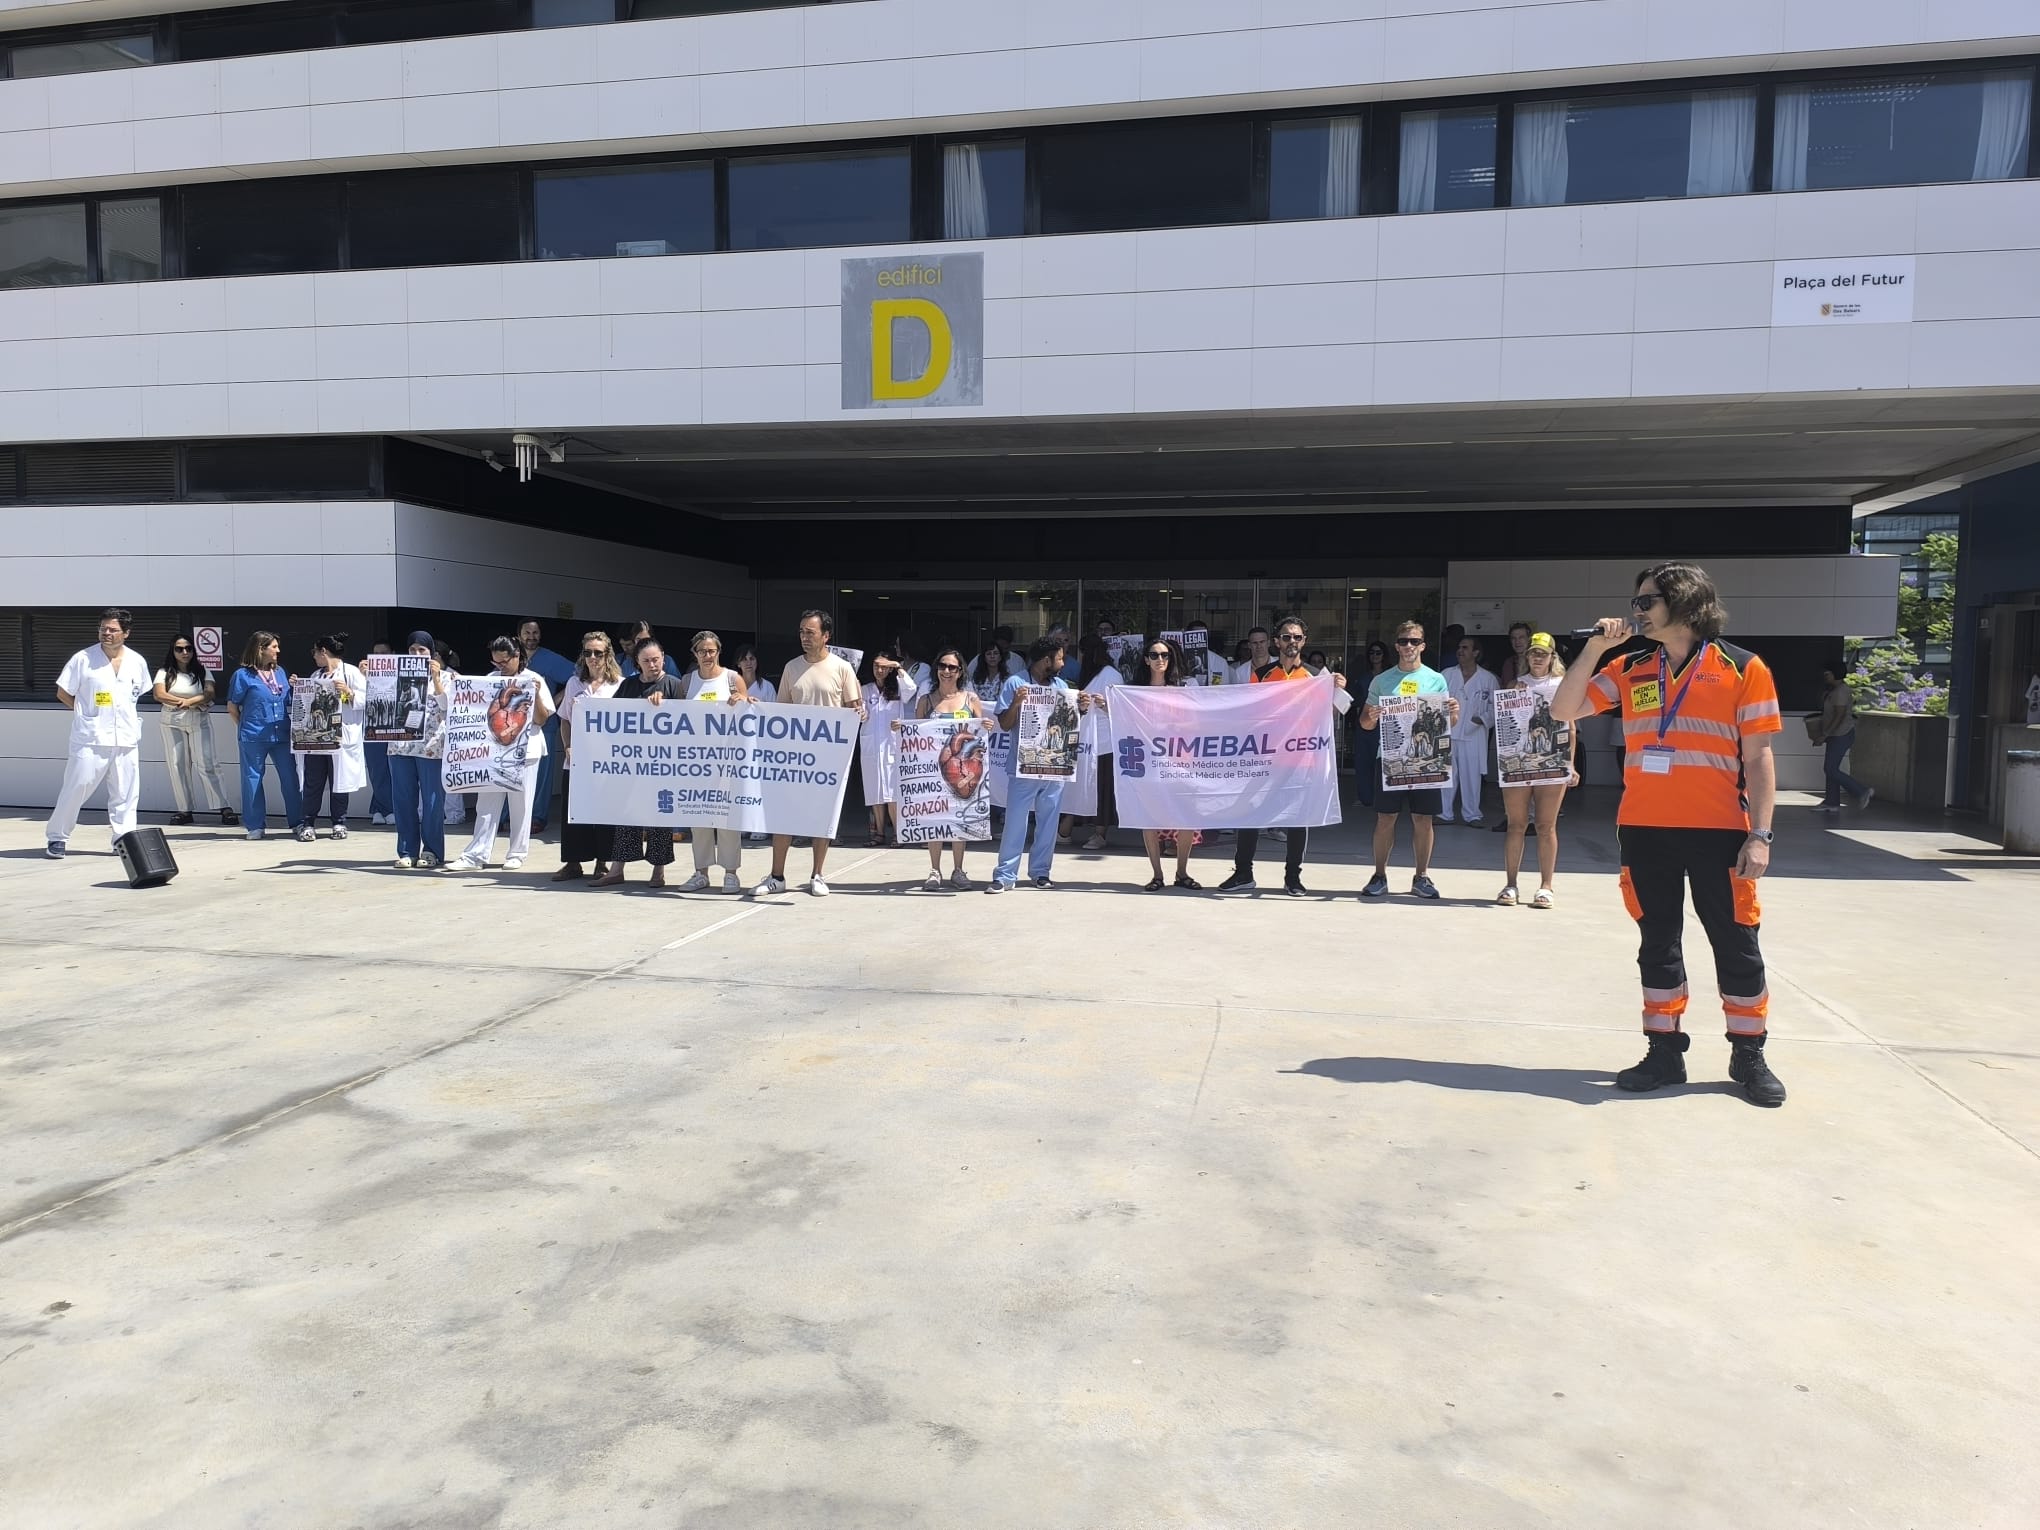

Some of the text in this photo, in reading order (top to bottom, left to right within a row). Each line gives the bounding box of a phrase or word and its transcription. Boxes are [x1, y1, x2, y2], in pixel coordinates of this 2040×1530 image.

[878, 264, 942, 287] edifici
[1784, 274, 1904, 290] Plaça del Futur
[871, 298, 953, 400] D
[1184, 632, 1206, 644] LEGAL
[368, 658, 396, 670] ILEGAL
[400, 658, 428, 670] LEGAL
[456, 680, 473, 690] POR
[454, 690, 486, 704] AMOR
[1030, 696, 1055, 704] MINUTOS
[1381, 697, 1401, 706] TENGO
[1496, 690, 1516, 701] TENGO
[1635, 696, 1657, 707] HUELGA
[1382, 703, 1416, 715] 5 MINUTOS
[1497, 697, 1532, 711] 5 MINUTOS
[450, 712, 486, 726] PROFESIÓN
[585, 710, 848, 744] HUELGA NACIONAL
[901, 725, 920, 738] POR
[448, 730, 486, 744] PARAMOS
[901, 736, 936, 753] AMOR
[1151, 734, 1330, 757] SIMEBAL CESM
[447, 743, 490, 764] CORAZÓN
[612, 744, 816, 766] POR UN ESTATUTO PROPIO
[901, 754, 918, 764] A LA
[450, 764, 462, 772] DEL
[899, 760, 939, 776] PROFESIÓN
[1192, 760, 1224, 768] Médico
[446, 768, 493, 787] SISTEMA.
[592, 760, 838, 785] PARA MÉDICOS Y FACULTATIVOS
[900, 781, 942, 796] PARAMOS
[678, 789, 762, 806] SIMEBAL CESM
[901, 796, 949, 818] CORAZÓN
[906, 819, 920, 827] DEL
[901, 824, 956, 842] SISTEMA.
